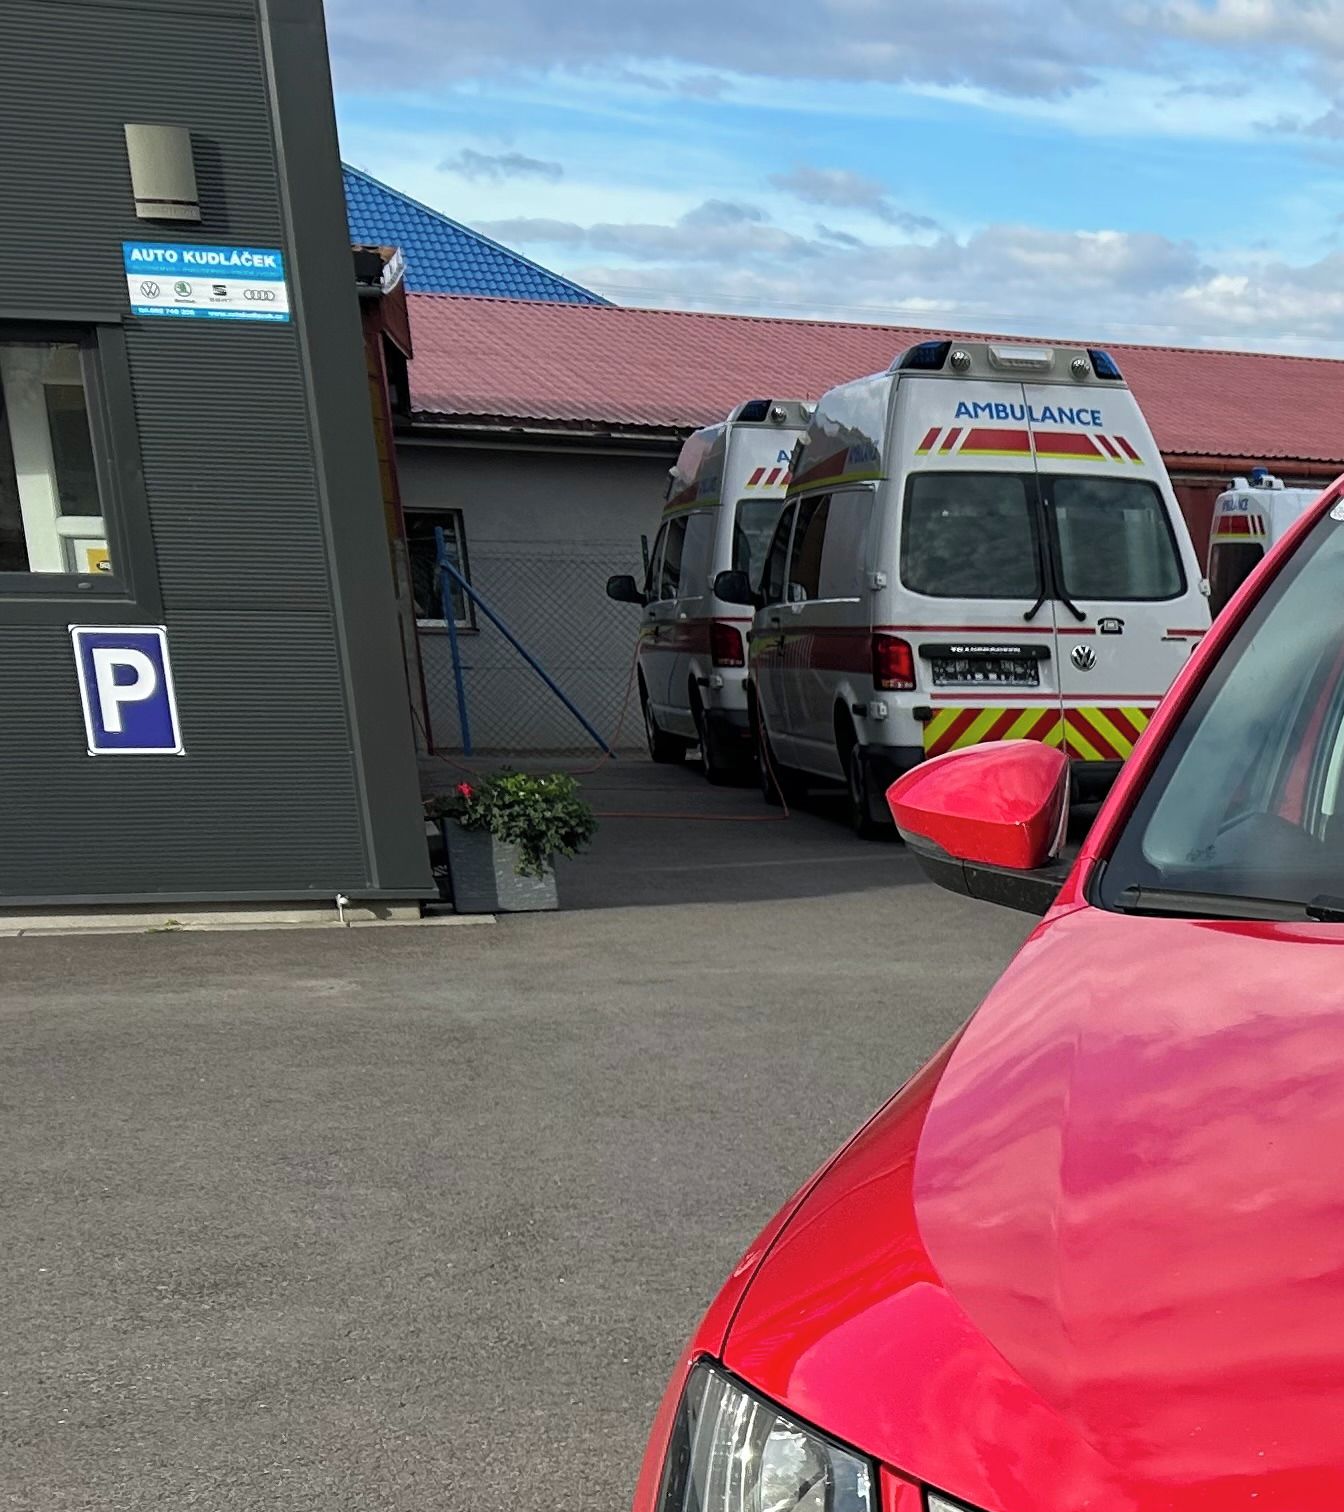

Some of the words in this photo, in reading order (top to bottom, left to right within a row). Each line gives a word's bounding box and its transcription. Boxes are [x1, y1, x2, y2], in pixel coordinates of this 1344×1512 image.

[131, 248, 178, 263] AUTO
[183, 250, 277, 268] KUDLÁČEK
[954, 401, 1103, 427] AMBULANCE
[91, 647, 156, 733] P
